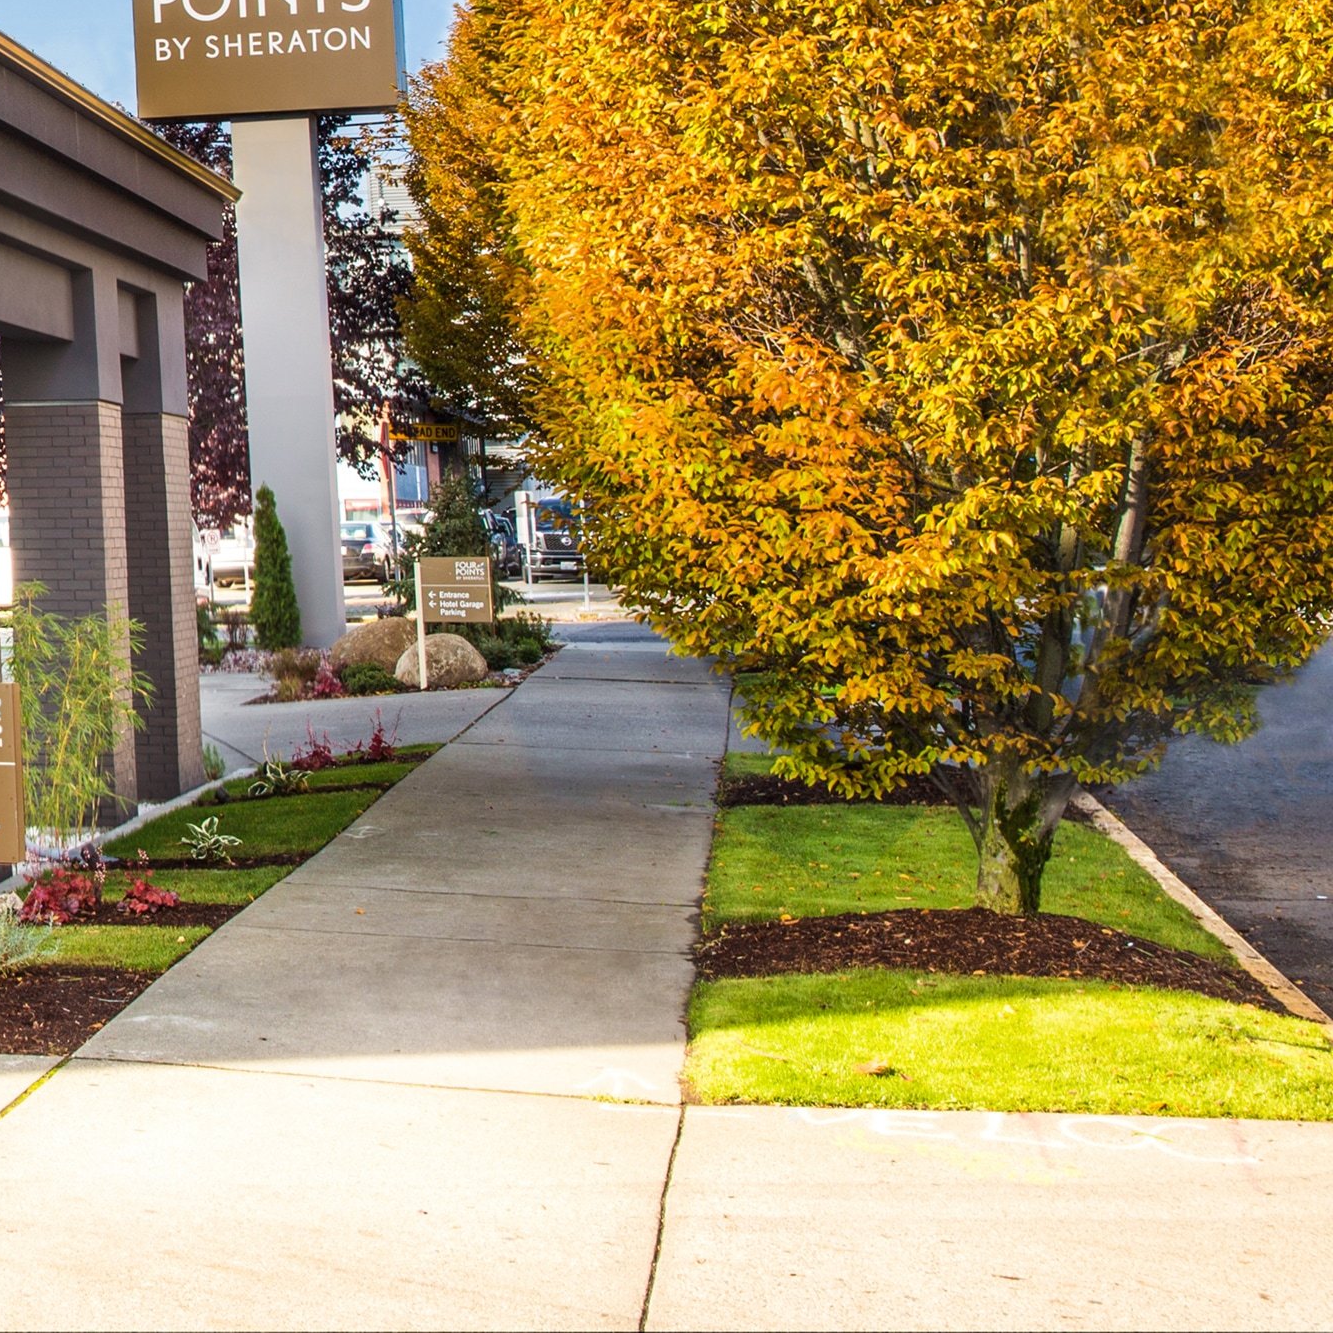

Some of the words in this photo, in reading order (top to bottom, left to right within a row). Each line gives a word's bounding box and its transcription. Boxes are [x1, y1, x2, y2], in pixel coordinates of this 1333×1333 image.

[154, 36, 191, 62] BY
[205, 26, 371, 59] SHERATON
[435, 427, 455, 439] END
[455, 561, 478, 569] FOUR
[455, 568, 485, 576] POINTS
[439, 591, 470, 599] Entrance
[439, 600, 458, 608] Hotel
[459, 600, 484, 609] Garage
[440, 608, 466, 617] Parking
